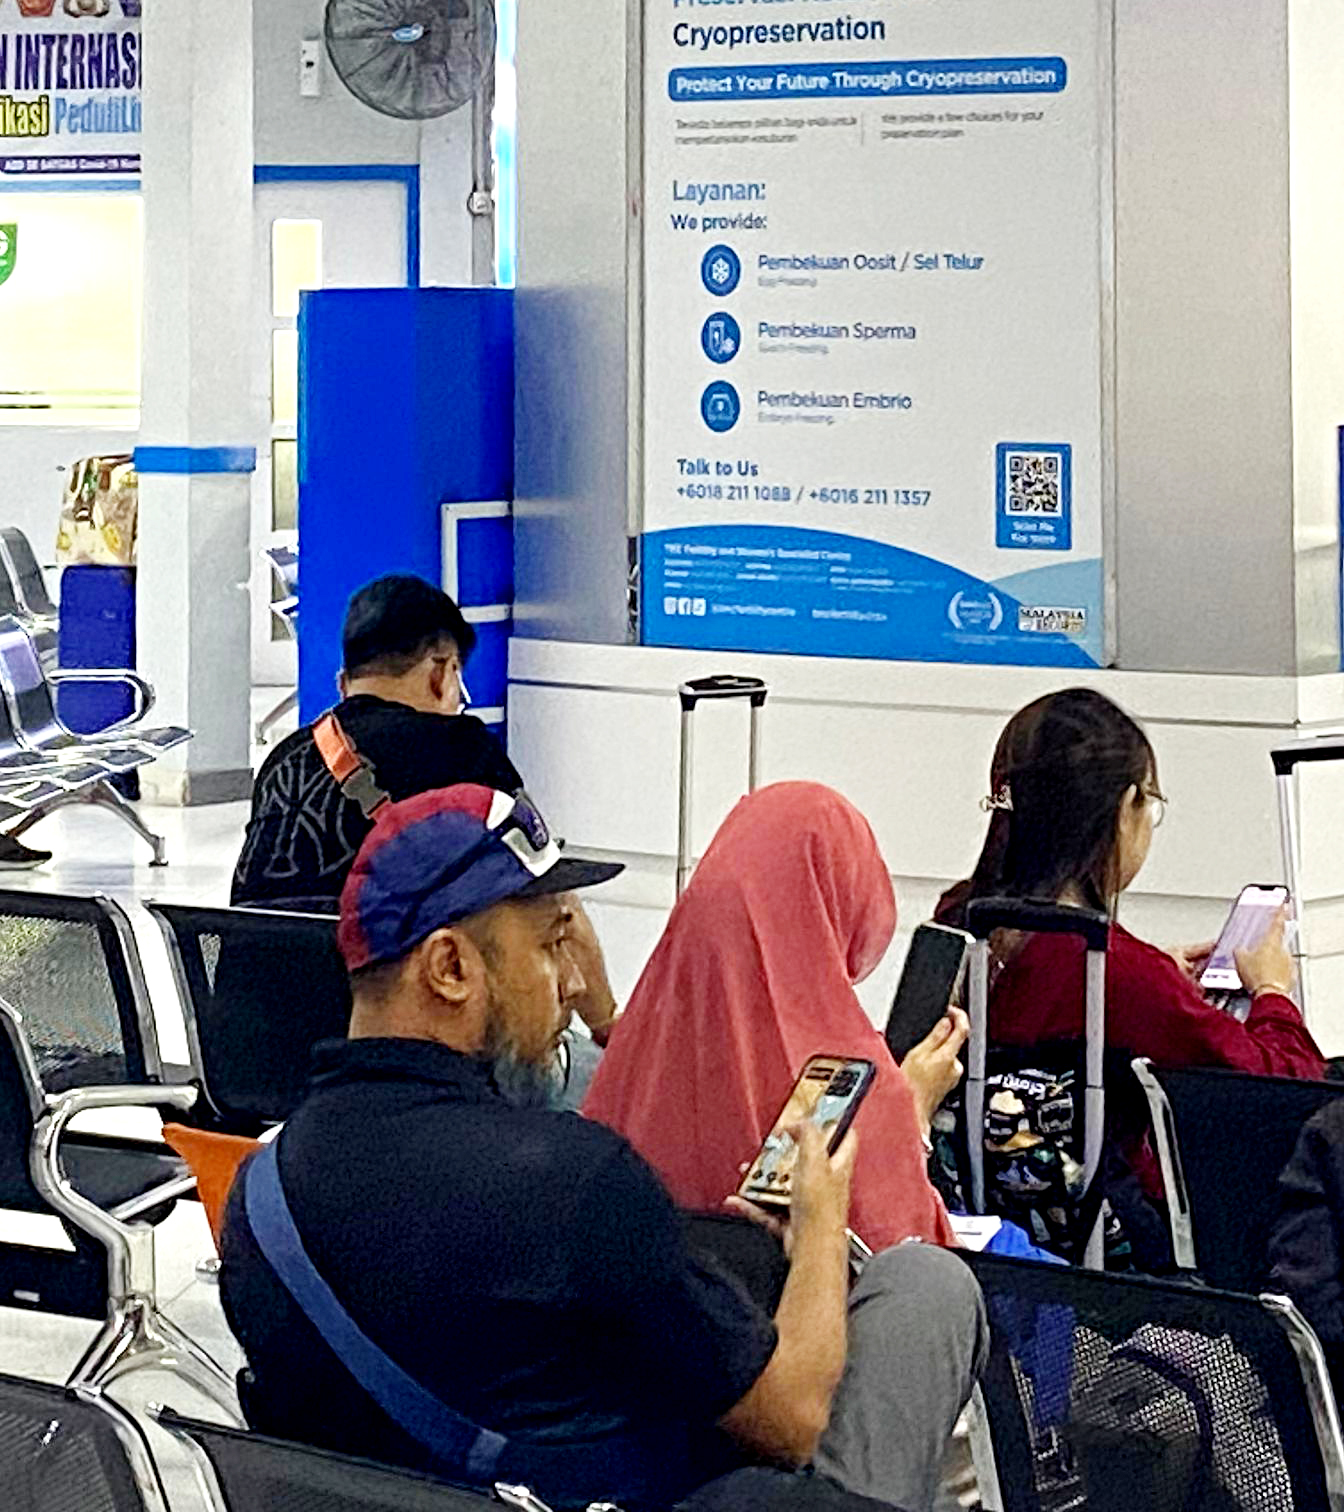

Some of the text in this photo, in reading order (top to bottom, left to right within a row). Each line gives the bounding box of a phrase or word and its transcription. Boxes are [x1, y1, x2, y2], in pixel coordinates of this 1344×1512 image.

[673, 15, 886, 49] Cryopreservation
[676, 66, 1057, 93] Protect Your Future Through Cryopreservation
[673, 180, 766, 206] Layanan:
[671, 211, 767, 233] We provide:
[758, 251, 985, 273] Pembekuan Oosit / Sel Telur
[758, 321, 917, 341] Pembekuan Sperma
[758, 390, 913, 409] Pembekuan Embrio
[677, 458, 759, 477] Talk to Us
[676, 484, 723, 500] +6018
[727, 486, 749, 501] 211
[863, 489, 888, 505] 211
[894, 490, 932, 507] 1357
